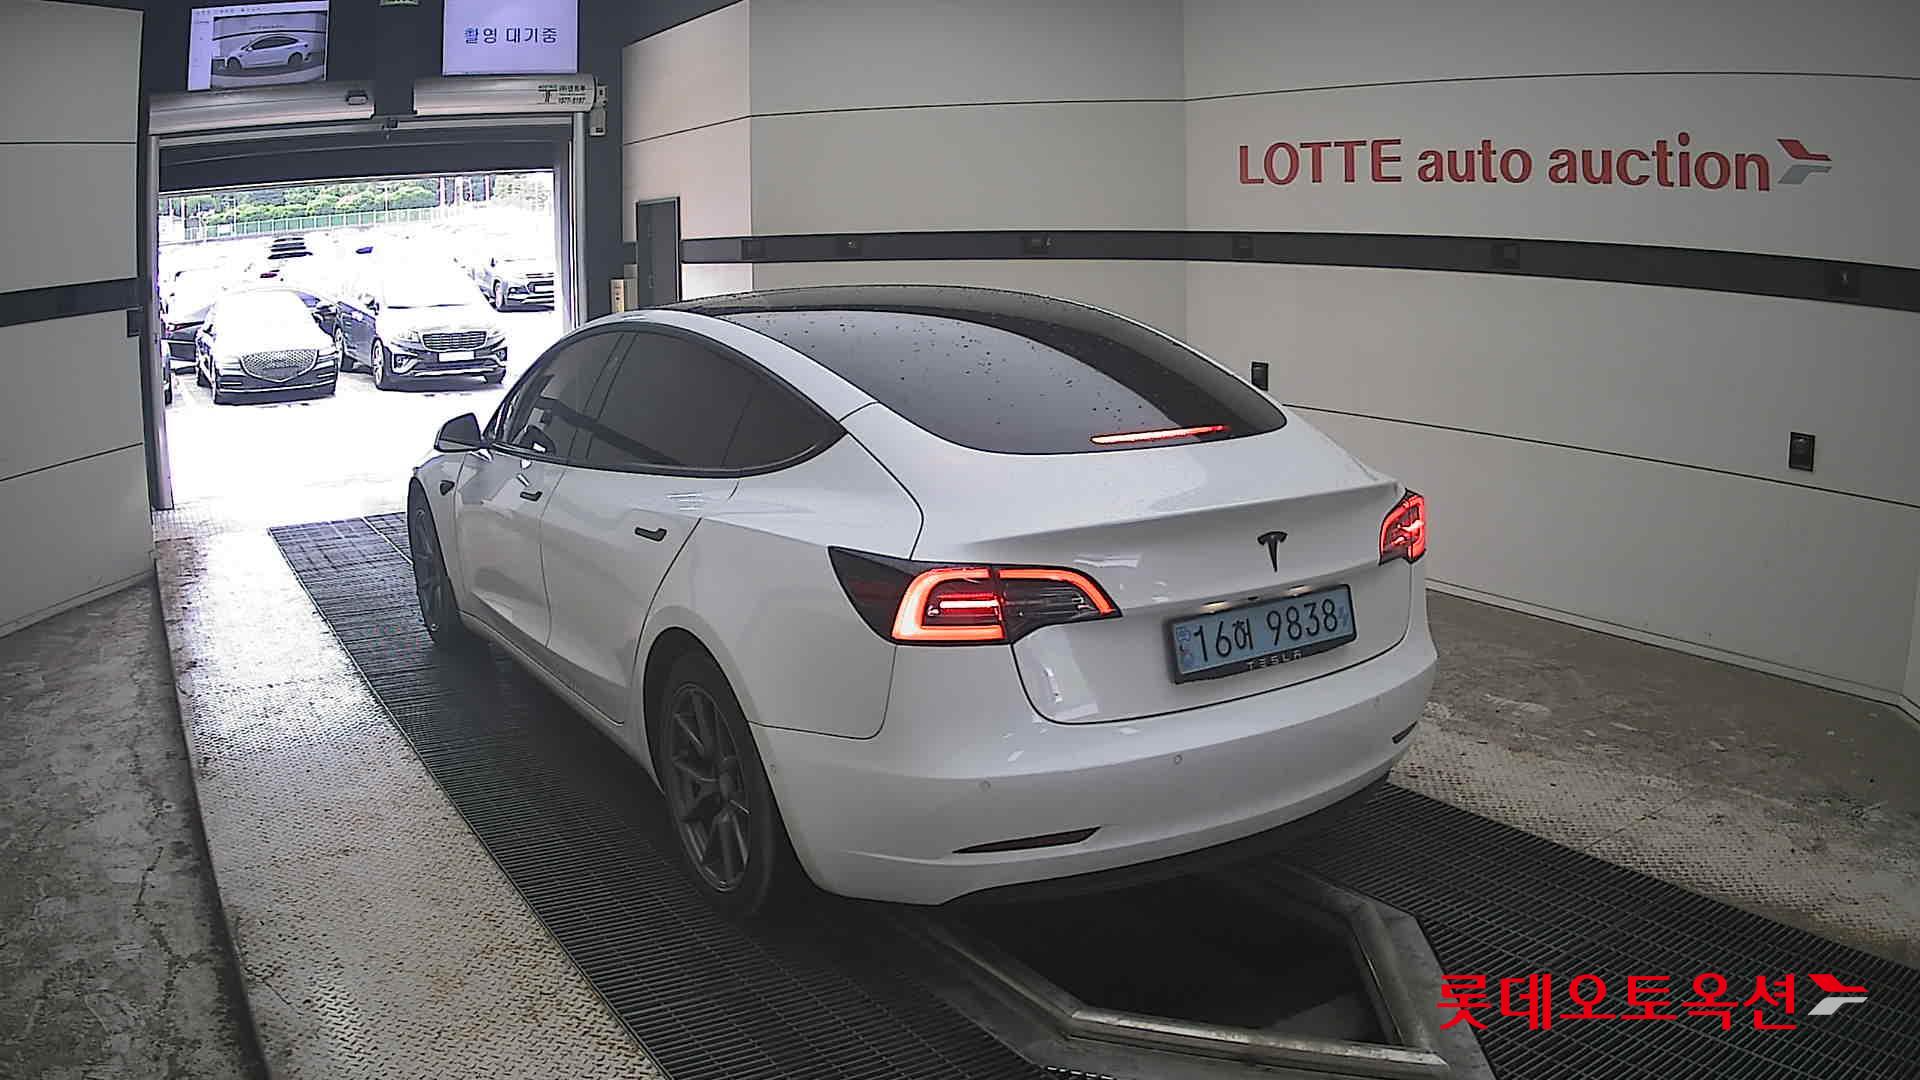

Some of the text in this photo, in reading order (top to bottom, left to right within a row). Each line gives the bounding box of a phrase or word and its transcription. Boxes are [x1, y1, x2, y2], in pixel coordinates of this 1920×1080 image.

[506, 27, 558, 44] 대기중
[1239, 131, 1771, 192] LOTTE auto auction
[1266, 598, 1339, 646] 9838
[1247, 652, 1303, 670] TESLA
